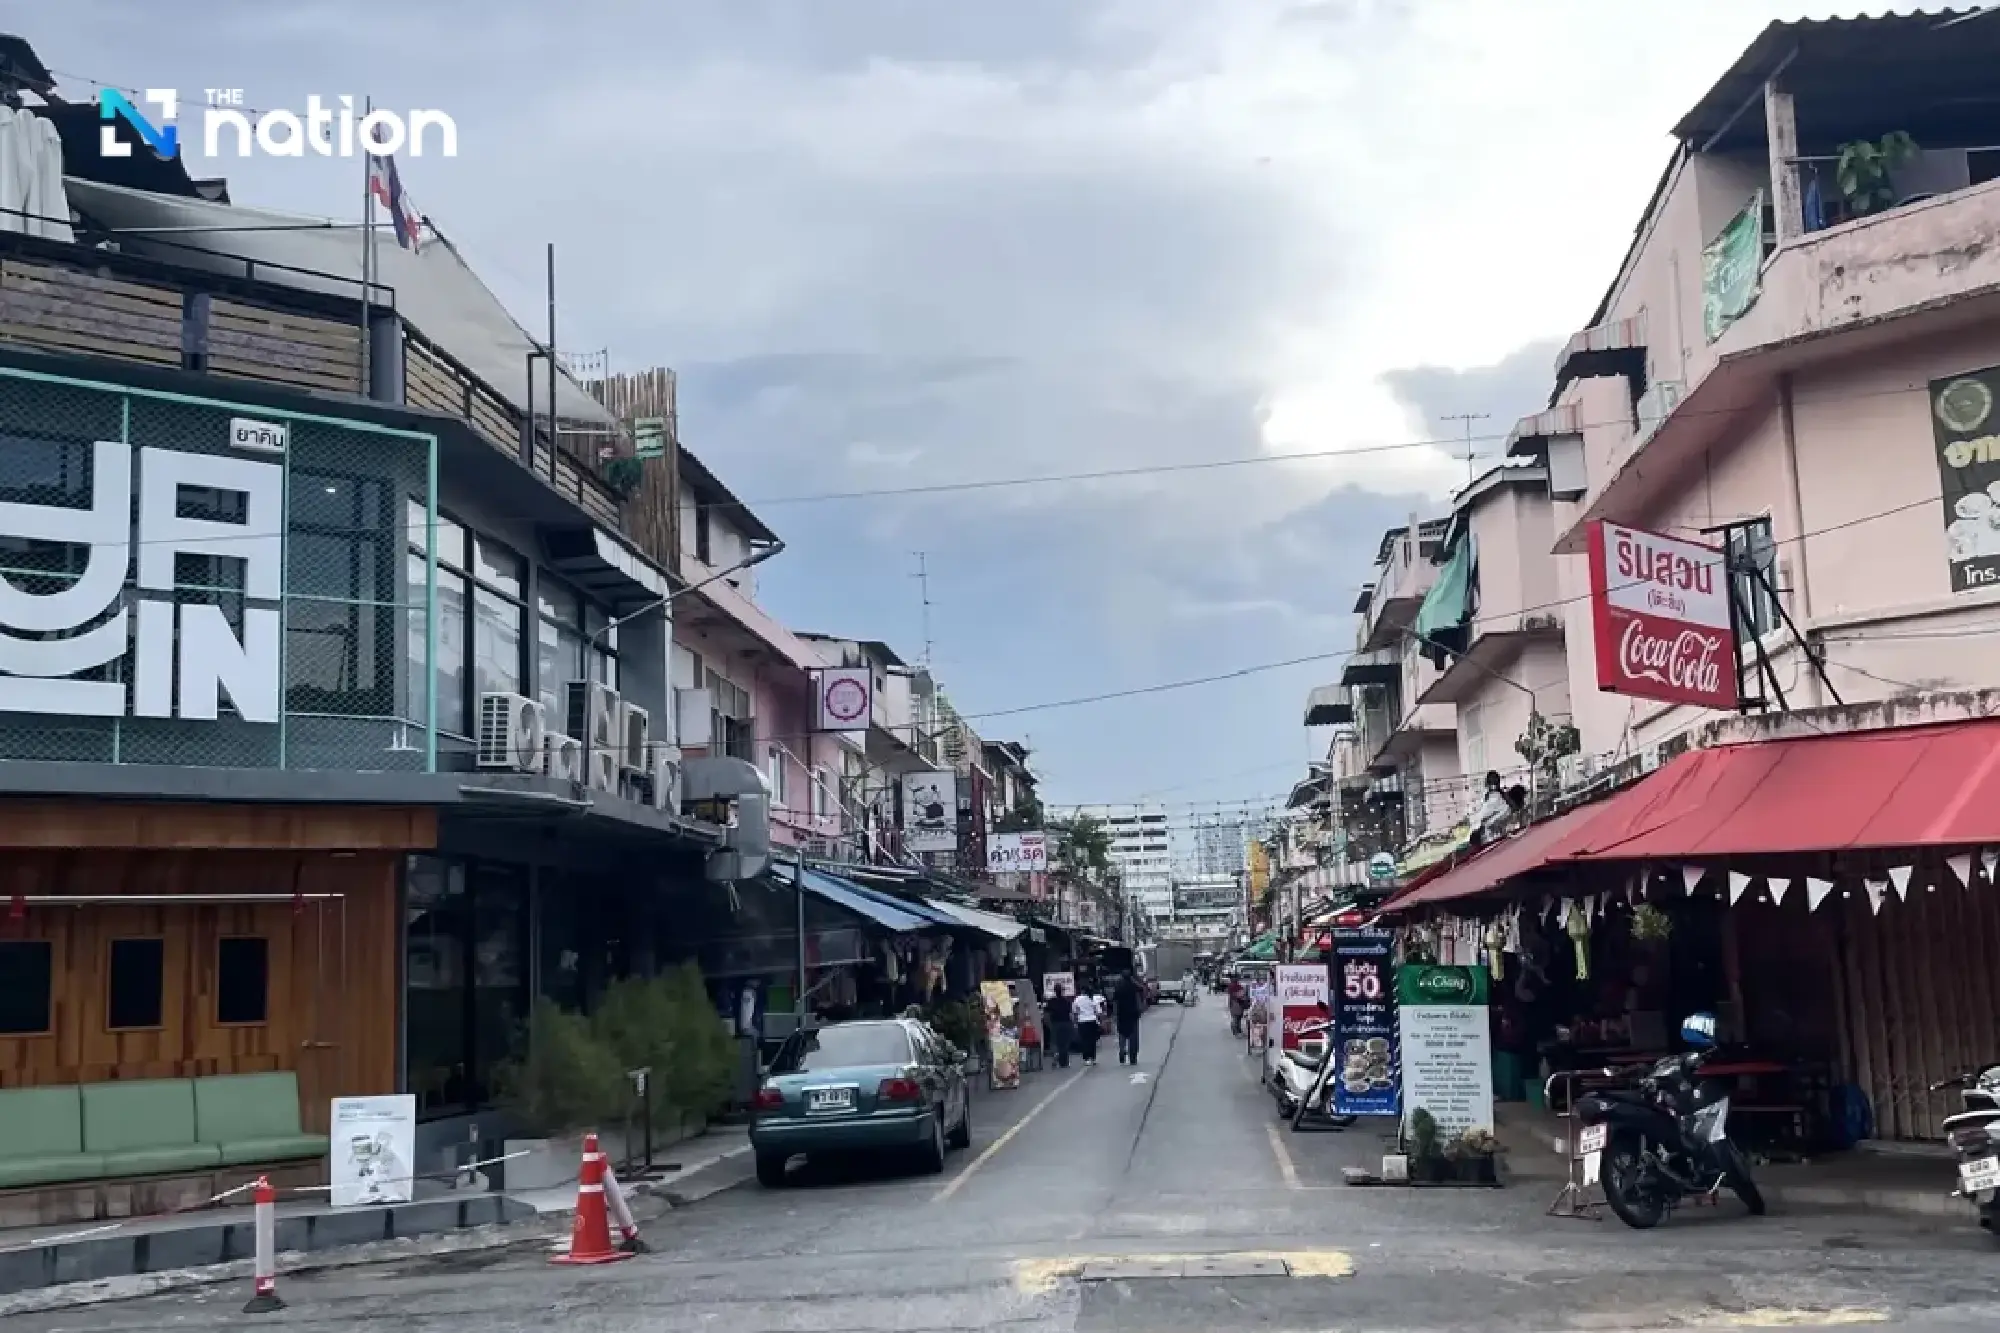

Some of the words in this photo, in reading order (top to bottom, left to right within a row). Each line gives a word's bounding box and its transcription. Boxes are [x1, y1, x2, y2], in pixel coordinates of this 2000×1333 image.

[1614, 528, 1714, 595] ริมสวน
[1620, 618, 1723, 692] Coca-Cola
